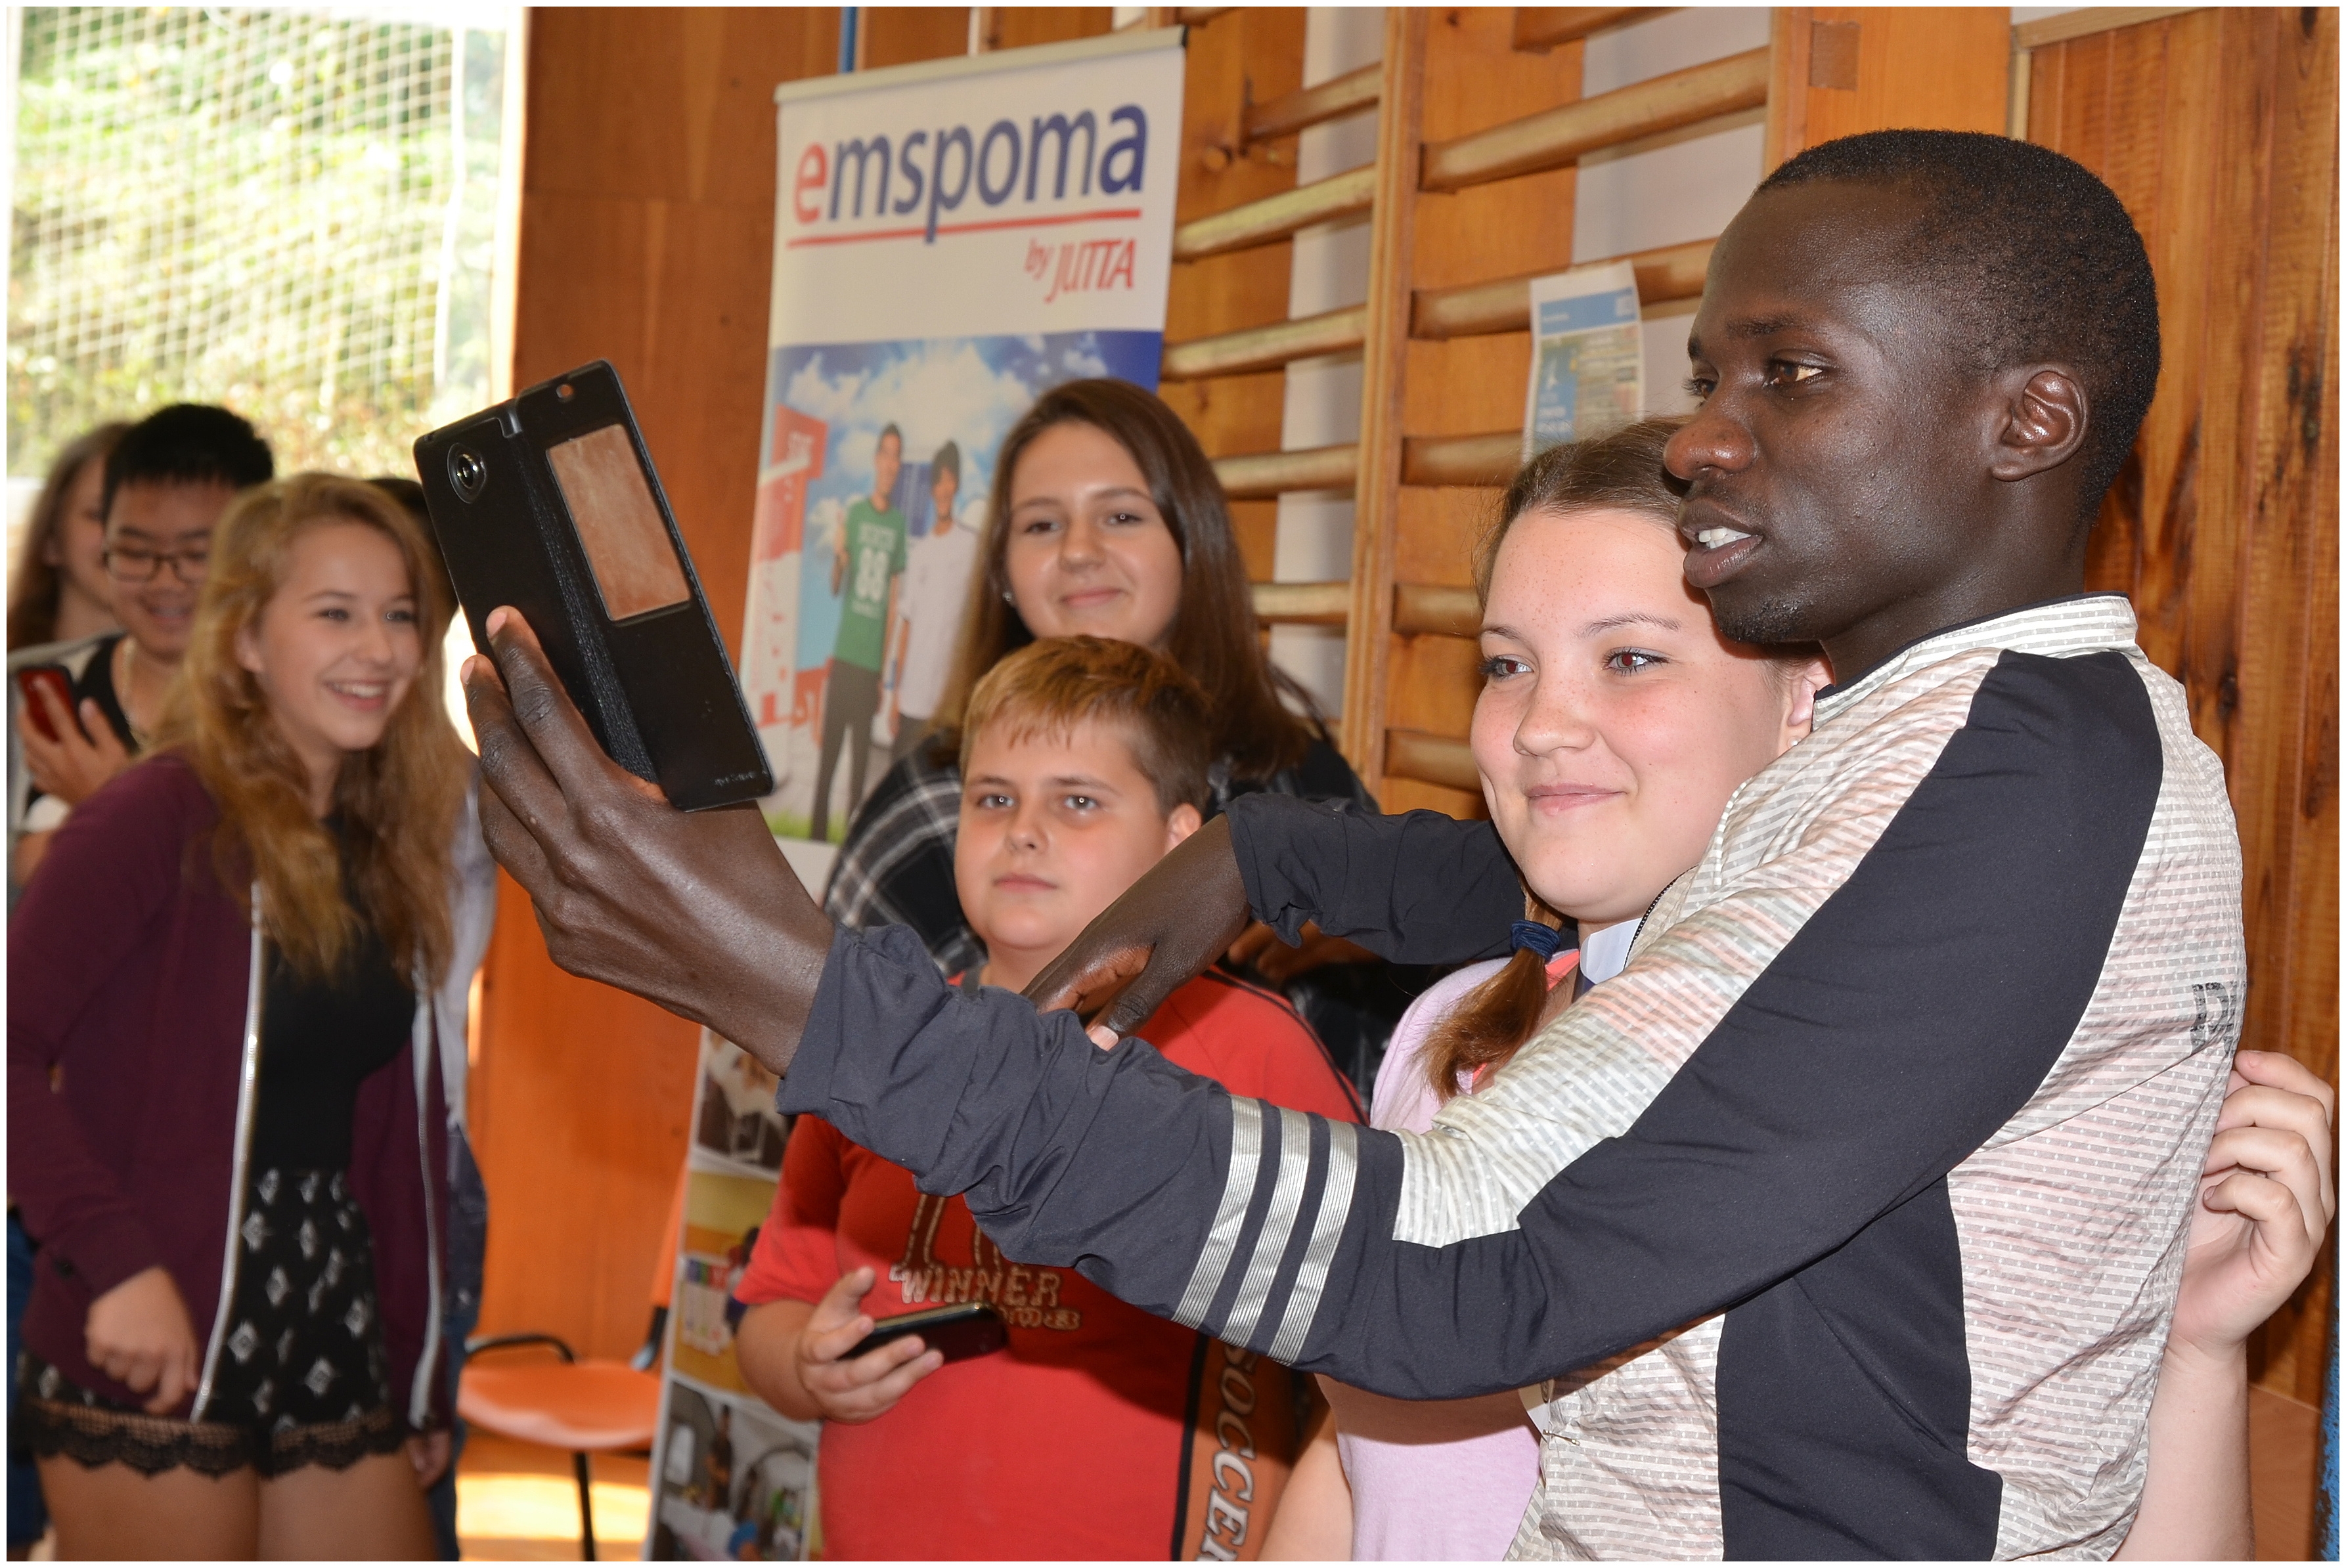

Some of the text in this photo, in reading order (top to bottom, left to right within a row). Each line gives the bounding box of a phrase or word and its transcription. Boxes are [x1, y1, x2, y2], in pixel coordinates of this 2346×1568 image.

[792, 103, 1149, 244] emspoma
[1024, 237, 1136, 304] by JUTTA
[902, 1267, 1060, 1307] WINNER
